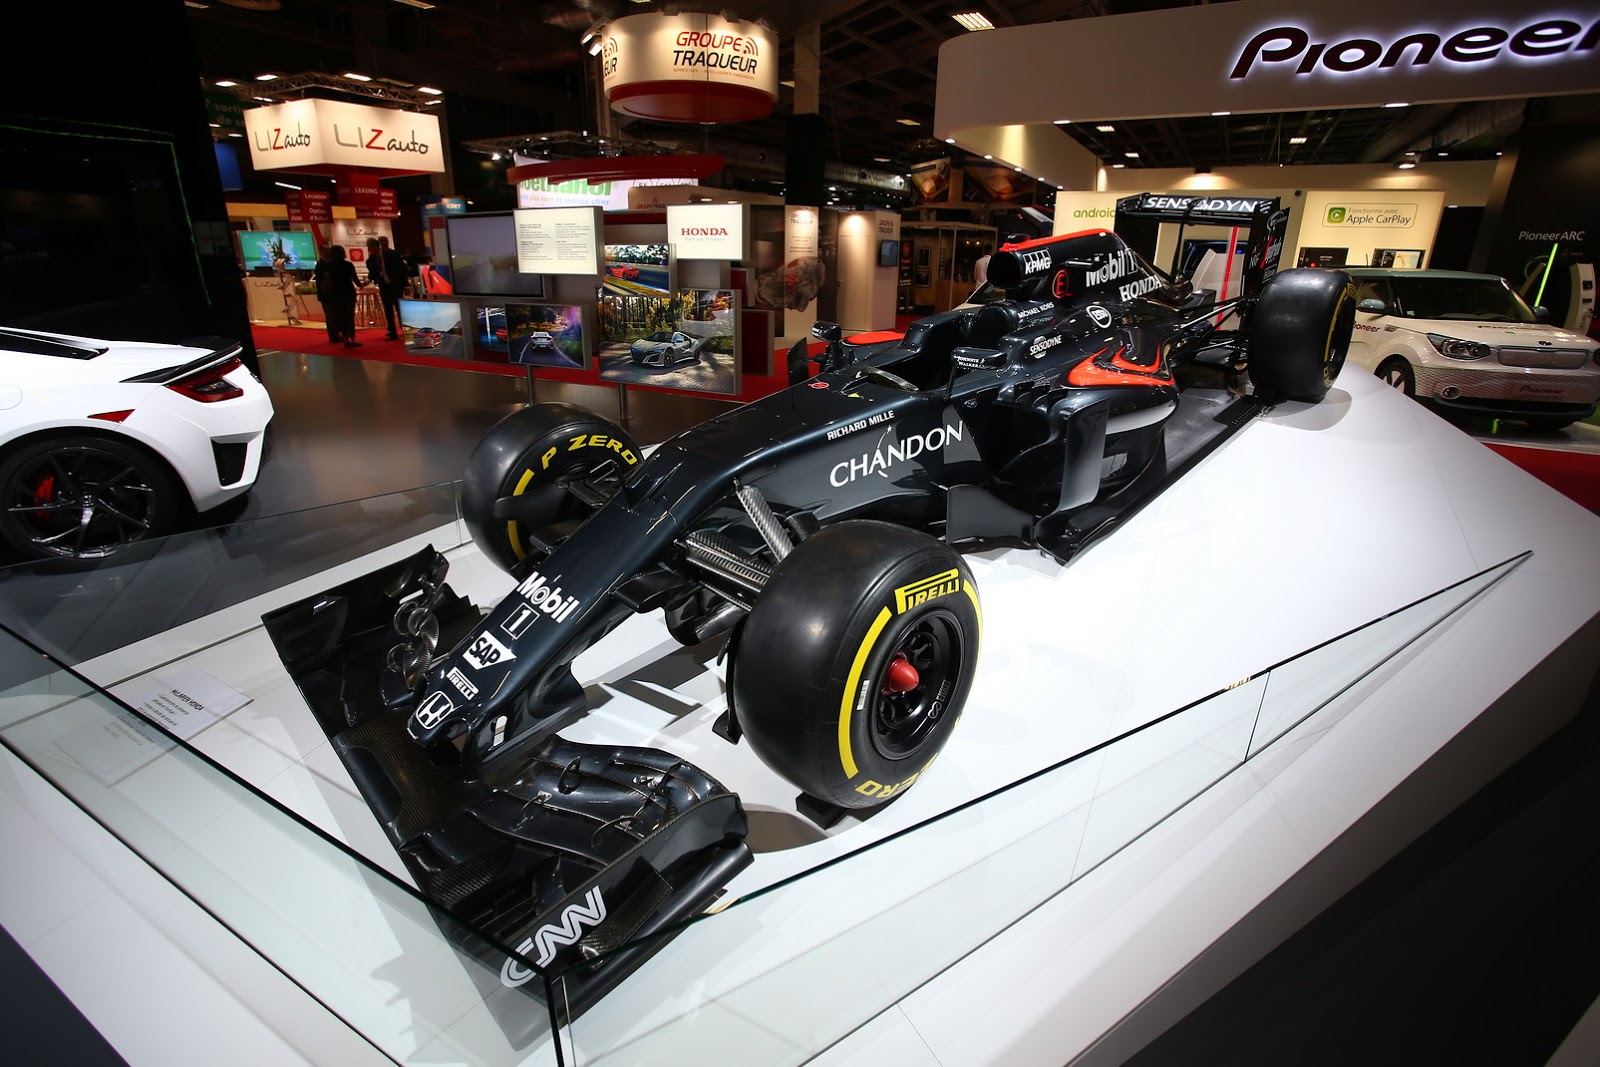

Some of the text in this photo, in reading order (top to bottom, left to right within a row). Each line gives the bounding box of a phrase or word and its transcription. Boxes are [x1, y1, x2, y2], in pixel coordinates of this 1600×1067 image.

[675, 31, 743, 52] GROUPE
[673, 50, 758, 75] TRAQUEUR
[254, 121, 311, 152] LIZauto
[333, 124, 429, 155] LIZauto
[354, 187, 379, 195] LEASING
[681, 227, 729, 236] HONDA
[1346, 214, 1411, 226] Apple CarPlay
[1518, 230, 1586, 241] Pioneer ARC
[1023, 253, 1052, 275] KPMG
[1085, 249, 1125, 288] Mobil
[1118, 274, 1163, 302] HONDA
[1017, 307, 1041, 319] MICHAEL
[1030, 334, 1063, 356] SENSODYNE
[1519, 385, 1565, 394] Pioneer
[826, 410, 895, 441] RICHARD MILLE
[541, 434, 638, 470] P ZERO
[828, 420, 964, 488] CHANDON
[515, 570, 580, 624] Mobil
[894, 567, 961, 616] PIRELLI
[468, 636, 501, 666] SAP
[446, 666, 480, 700] PIRELLI
[500, 884, 607, 989] CNN
